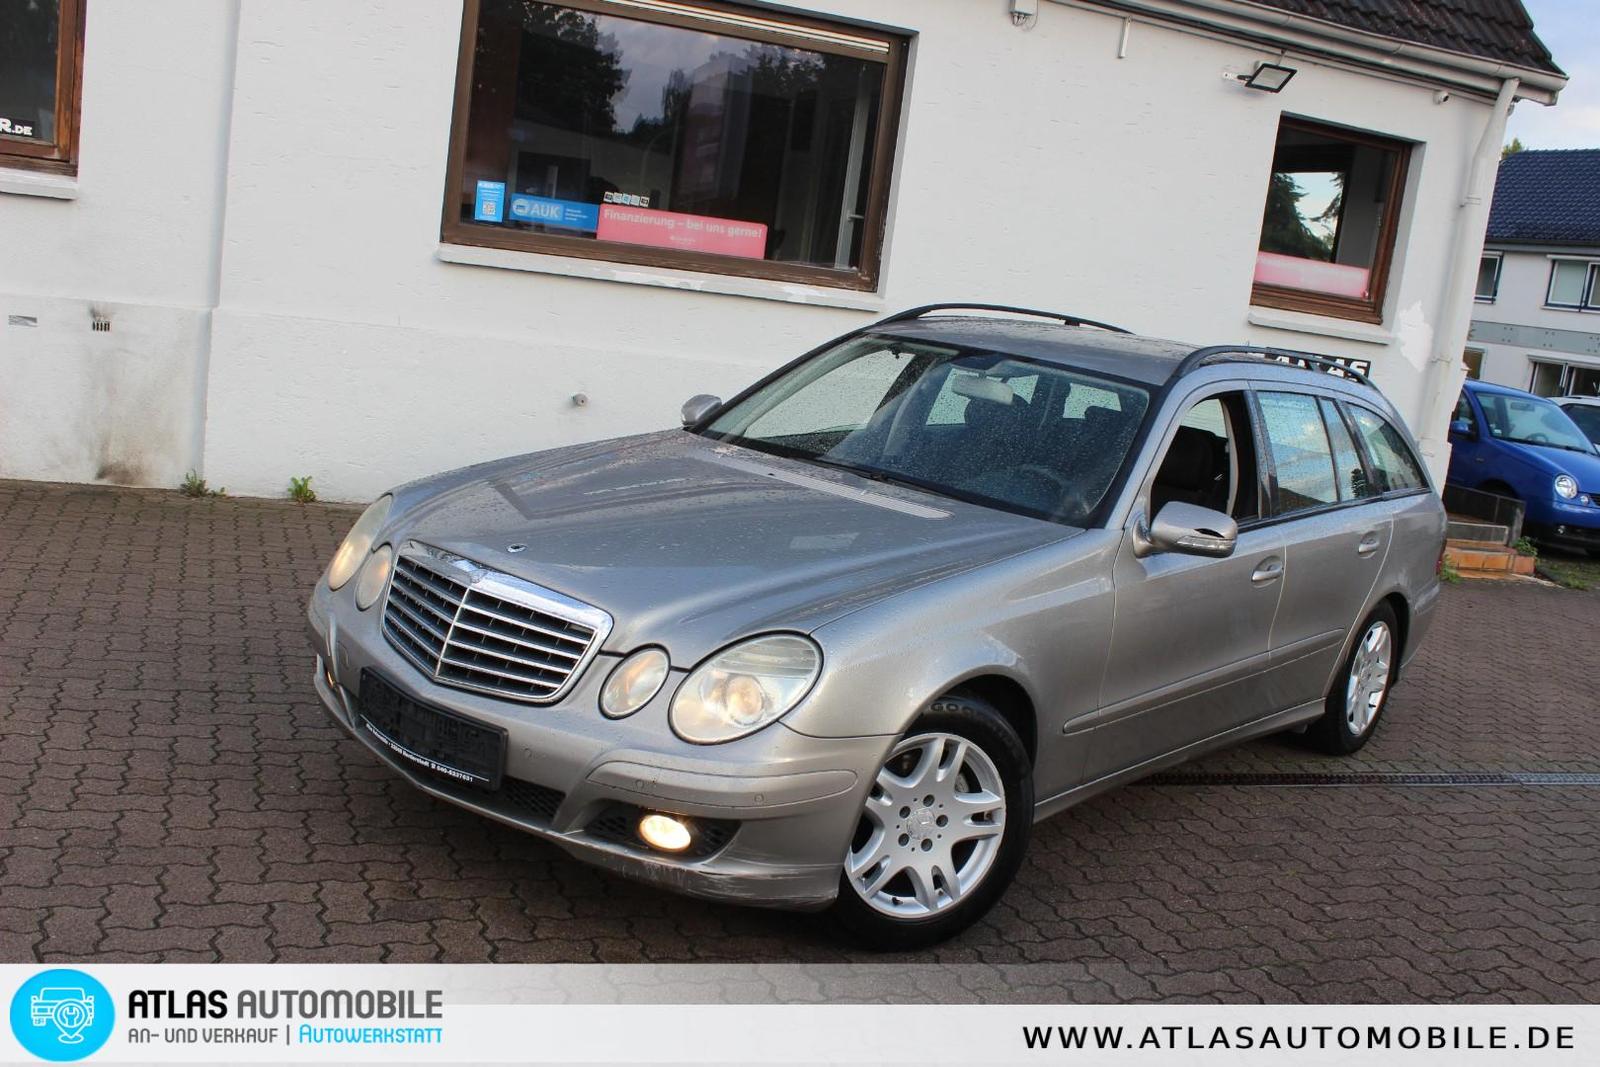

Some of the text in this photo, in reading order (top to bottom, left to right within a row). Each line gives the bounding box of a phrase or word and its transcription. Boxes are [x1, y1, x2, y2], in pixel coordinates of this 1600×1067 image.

[530, 203, 561, 219] AUK
[604, 208, 675, 229] Finanzierung
[686, 218, 703, 231] bei
[705, 224, 725, 234] uns
[727, 225, 763, 239] gerne!
